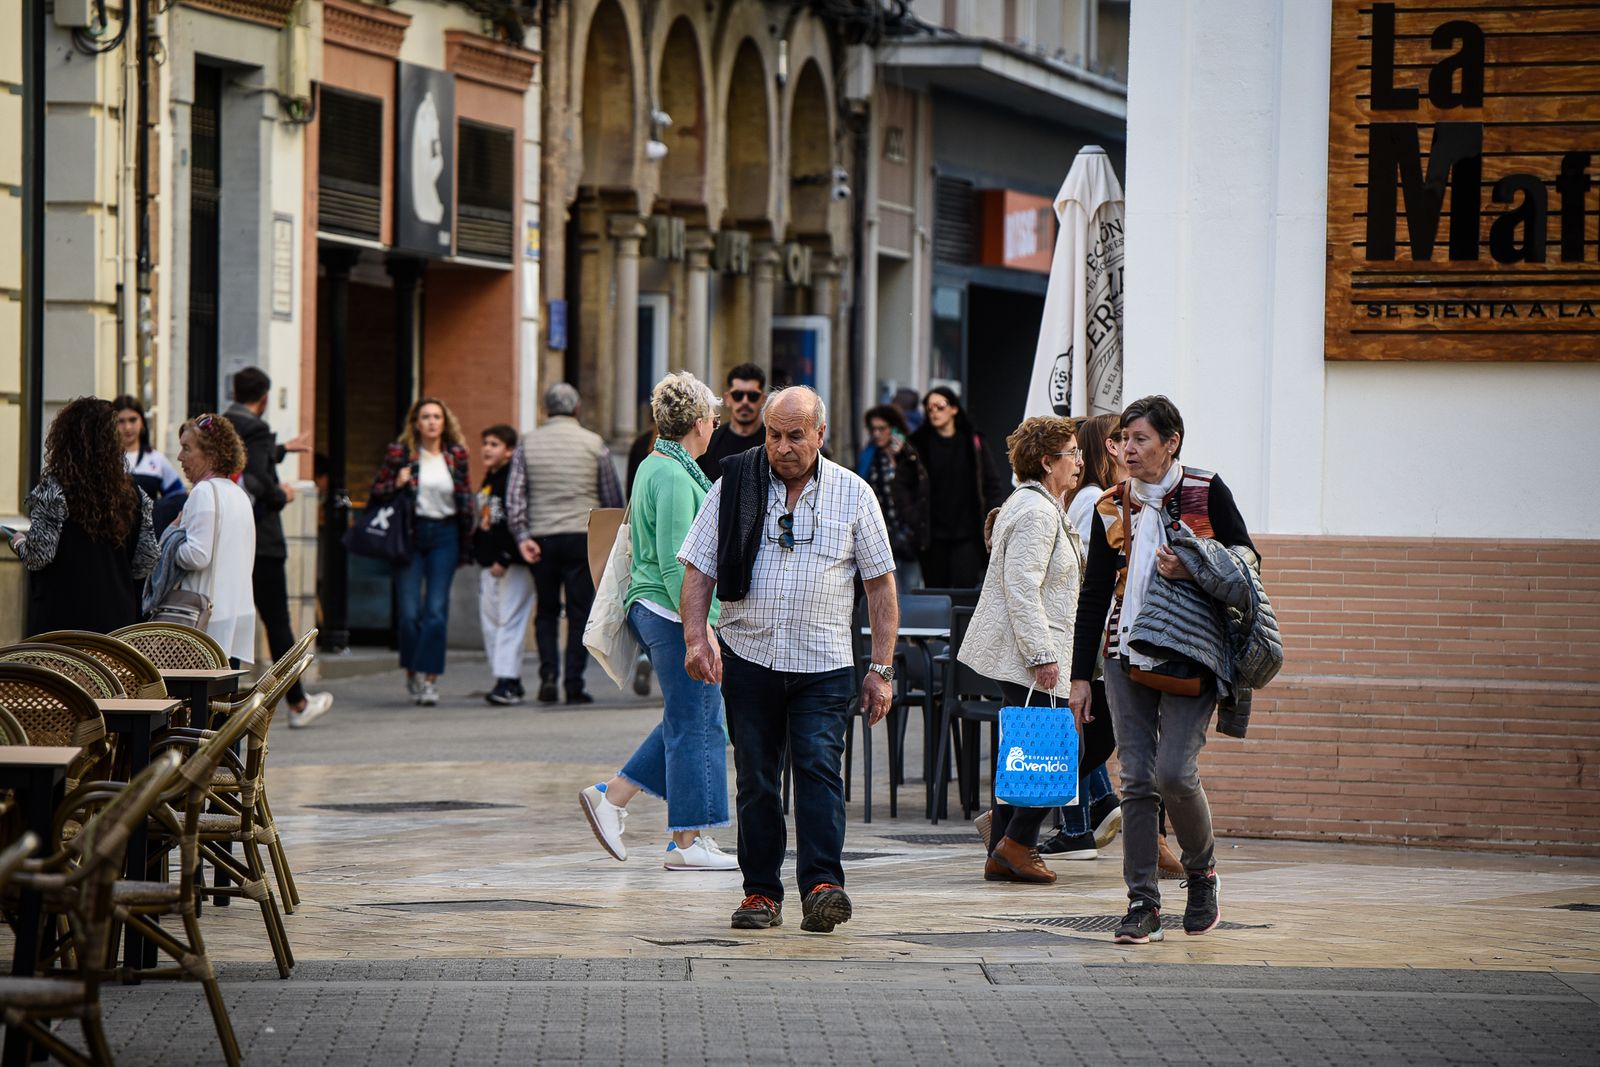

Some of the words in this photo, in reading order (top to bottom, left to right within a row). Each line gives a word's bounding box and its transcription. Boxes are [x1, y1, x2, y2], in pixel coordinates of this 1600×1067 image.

[1370, 3, 1485, 110] La
[1366, 122, 1600, 263] Maf
[1367, 303, 1400, 318] SE
[1413, 303, 1519, 318] SIENTA
[1528, 303, 1546, 318] A
[1559, 303, 1595, 318] LA
